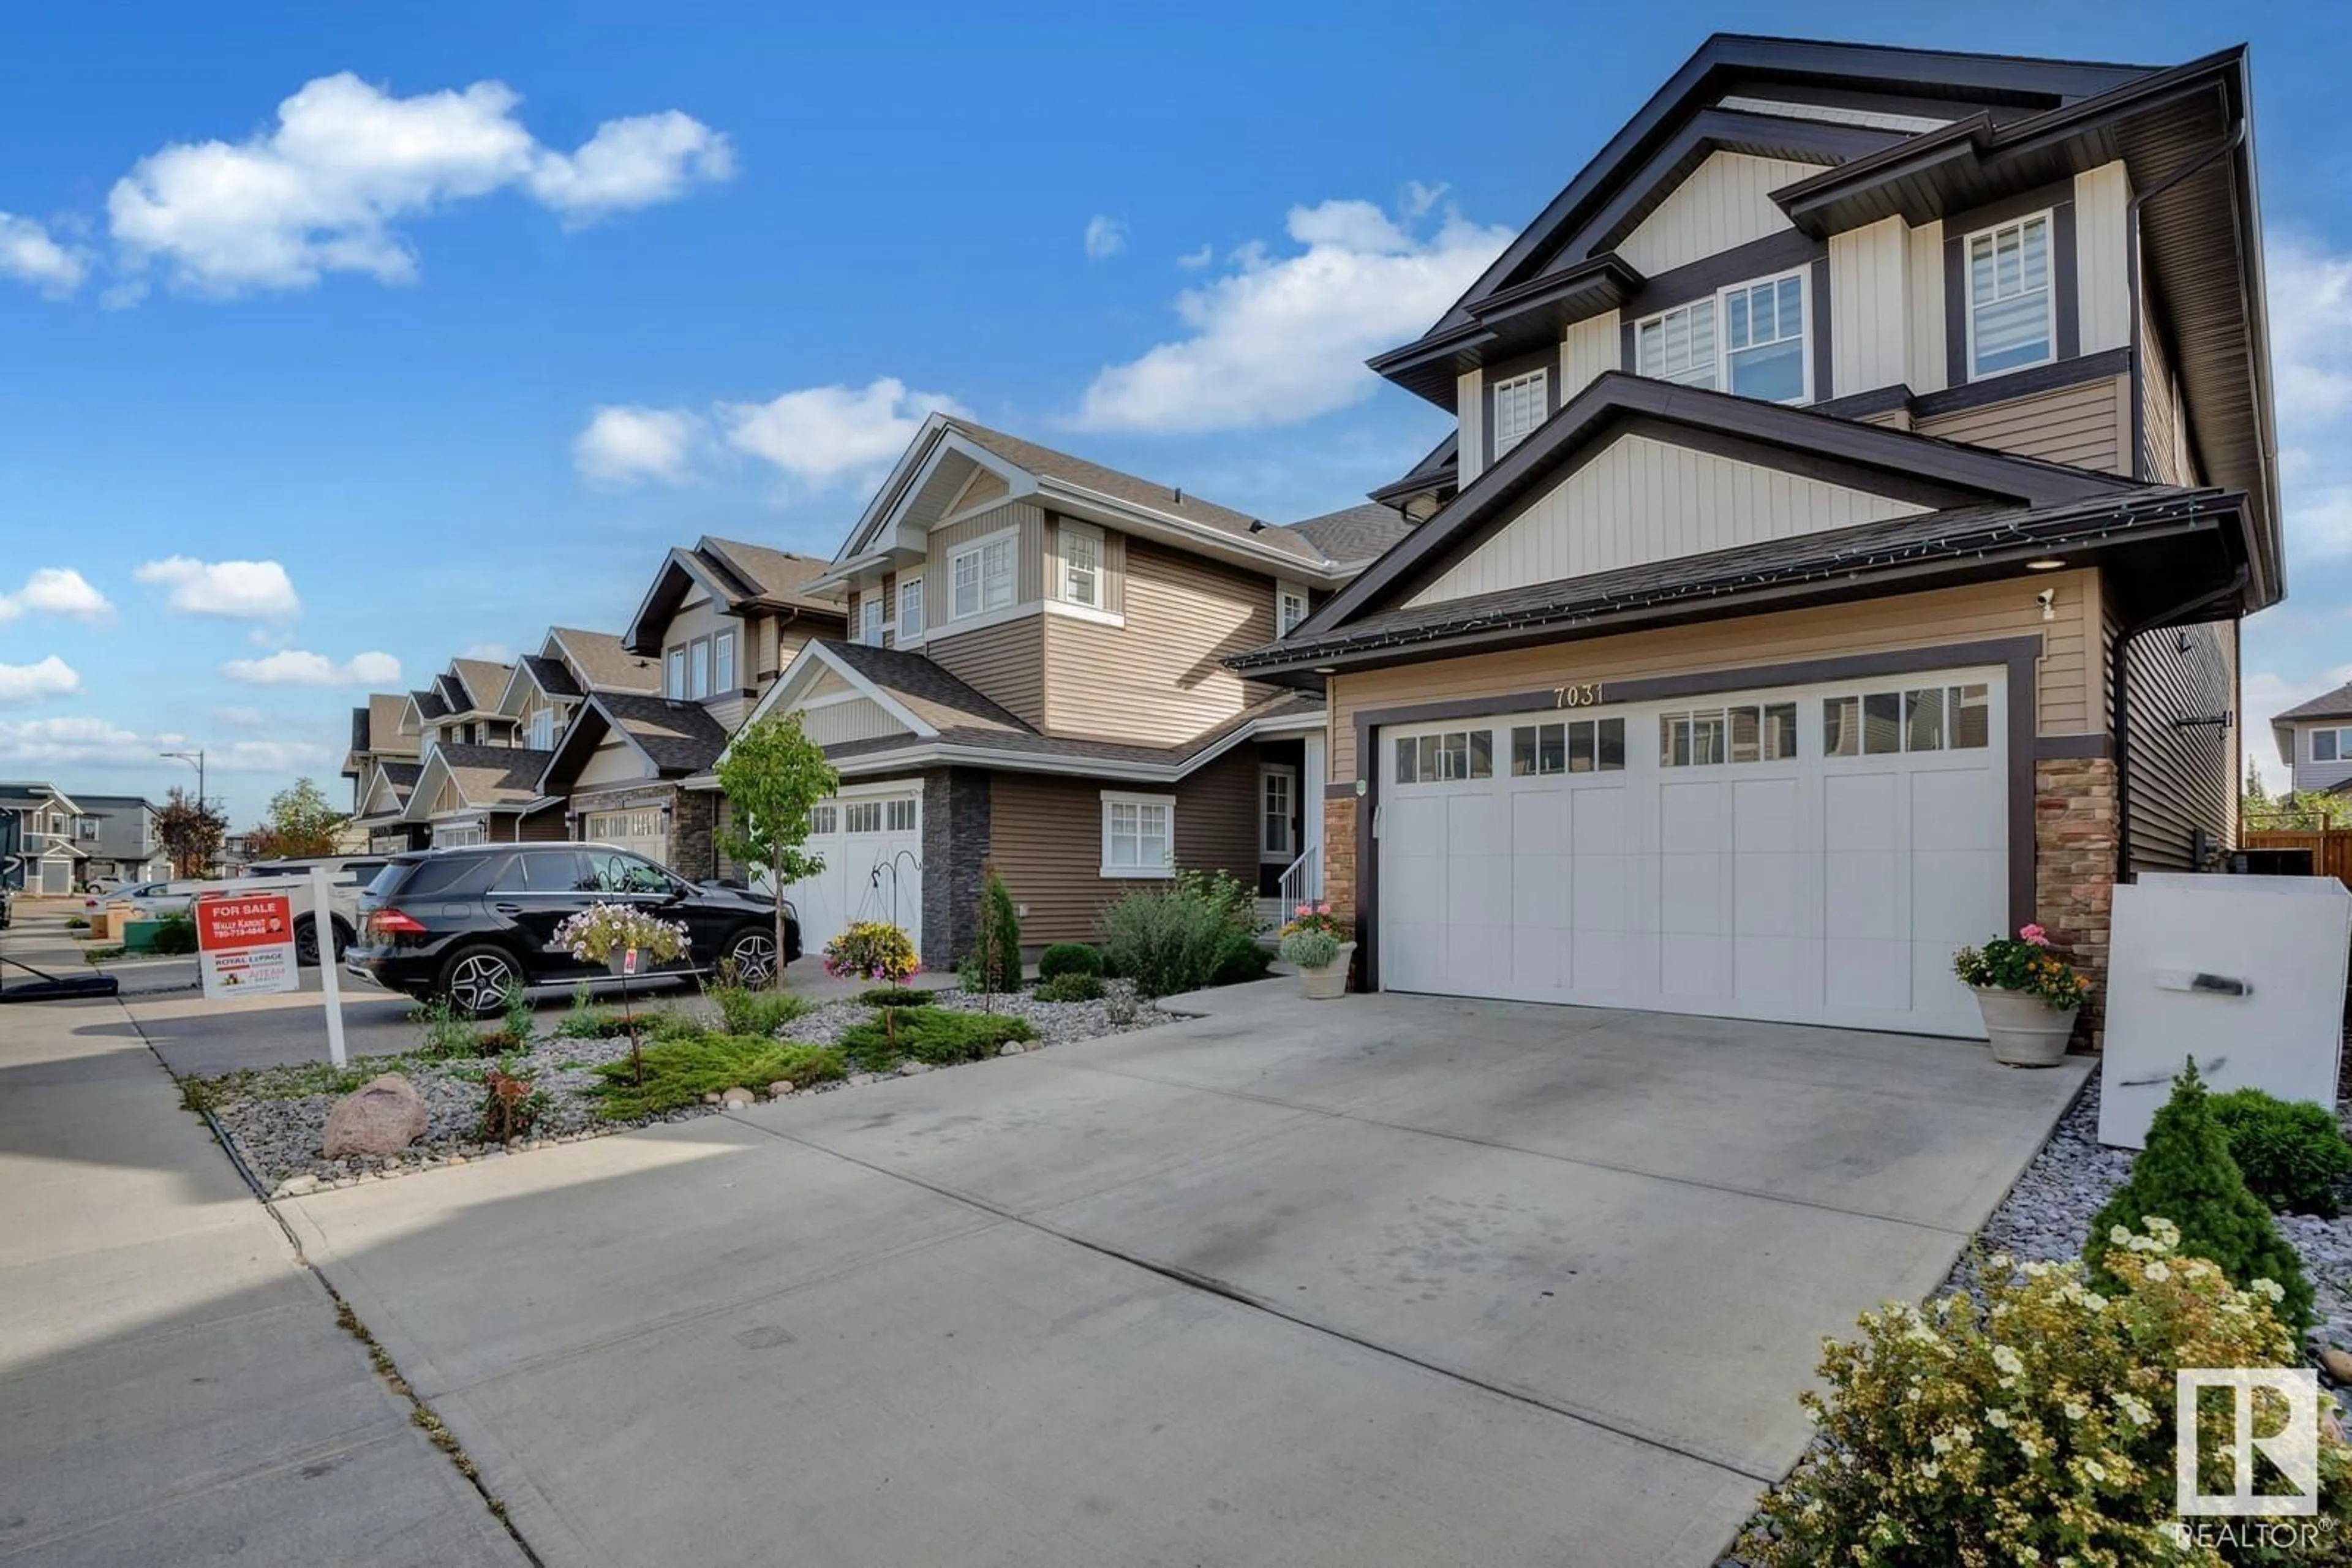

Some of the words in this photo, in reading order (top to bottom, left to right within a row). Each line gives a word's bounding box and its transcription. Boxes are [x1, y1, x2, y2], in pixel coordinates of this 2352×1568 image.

[1554, 682, 1602, 708] 7031
[213, 906, 239, 918] FOR
[243, 903, 276, 914] SALE
[216, 957, 247, 966] ROYAL
